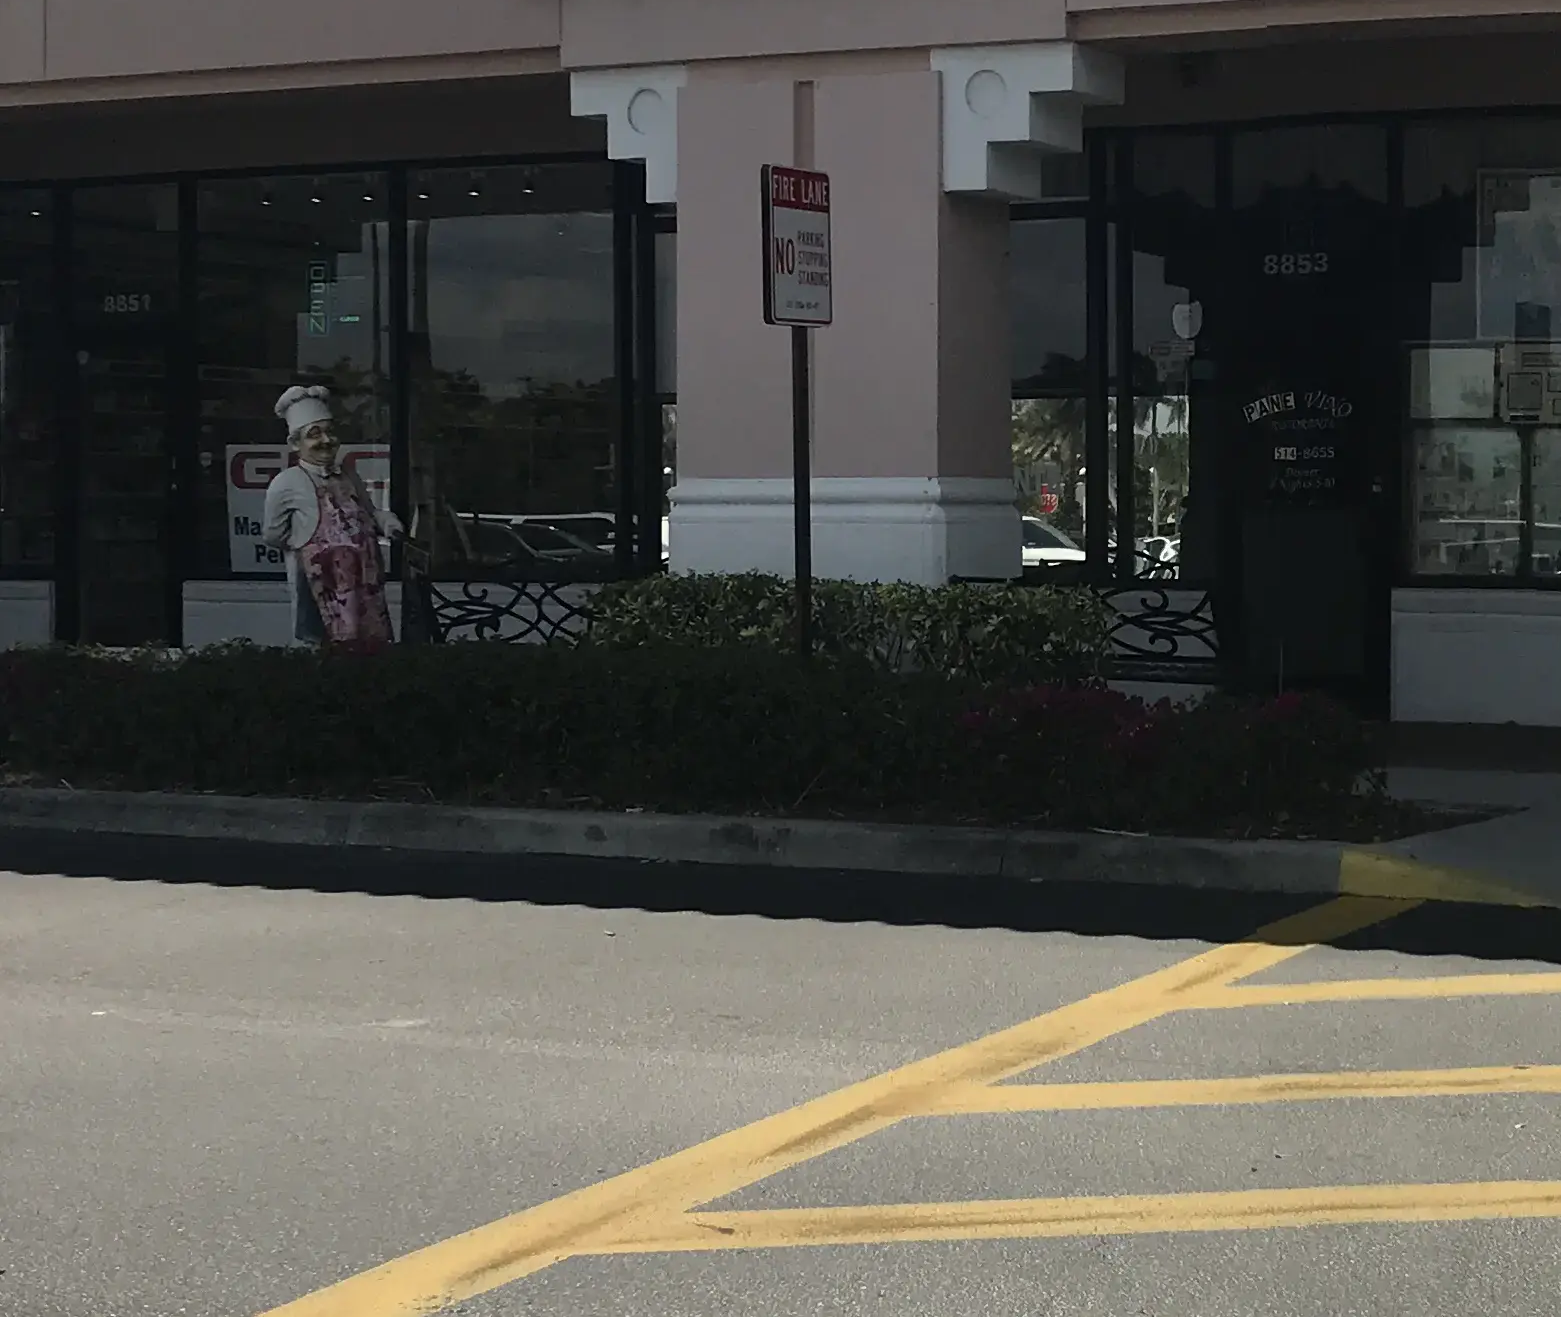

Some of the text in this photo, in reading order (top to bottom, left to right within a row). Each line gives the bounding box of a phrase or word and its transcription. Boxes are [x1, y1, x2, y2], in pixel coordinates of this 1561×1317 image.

[772, 173, 829, 207] FIRE LANE
[775, 236, 796, 276] NO
[1263, 252, 1329, 275] 8853
[1242, 391, 1296, 424] PANE
